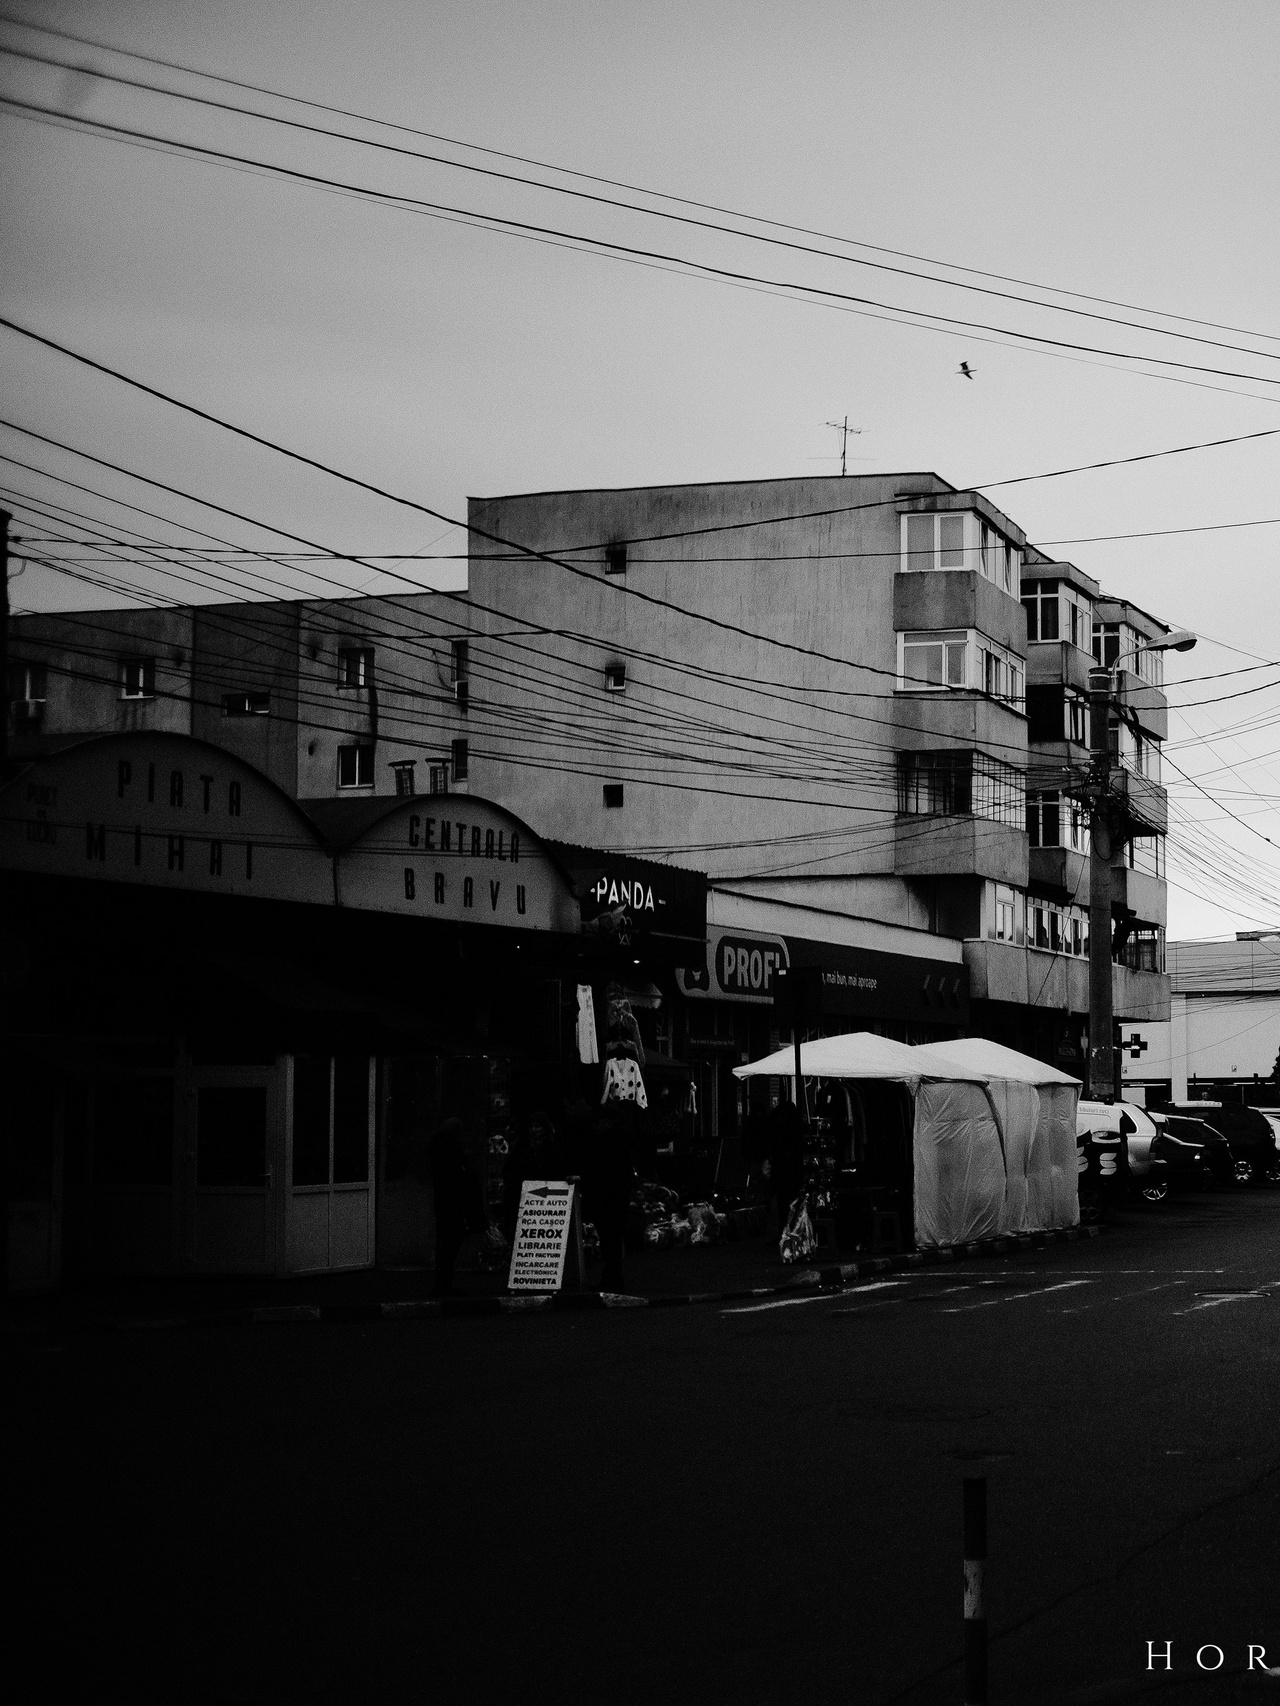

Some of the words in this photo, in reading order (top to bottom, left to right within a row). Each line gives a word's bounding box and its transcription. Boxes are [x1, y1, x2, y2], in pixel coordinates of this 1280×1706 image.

[118, 760, 241, 816] PIATA
[86, 821, 253, 880] MIHAI
[409, 815, 520, 864] CENTRALA
[404, 867, 526, 915] BRAVU
[596, 876, 655, 913] PANDA
[522, 1209, 567, 1217] ASIGURARI
[517, 1242, 562, 1250] LIBRARIE
[520, 1228, 563, 1239] XEROX
[513, 1276, 557, 1285] ROVINIETA
